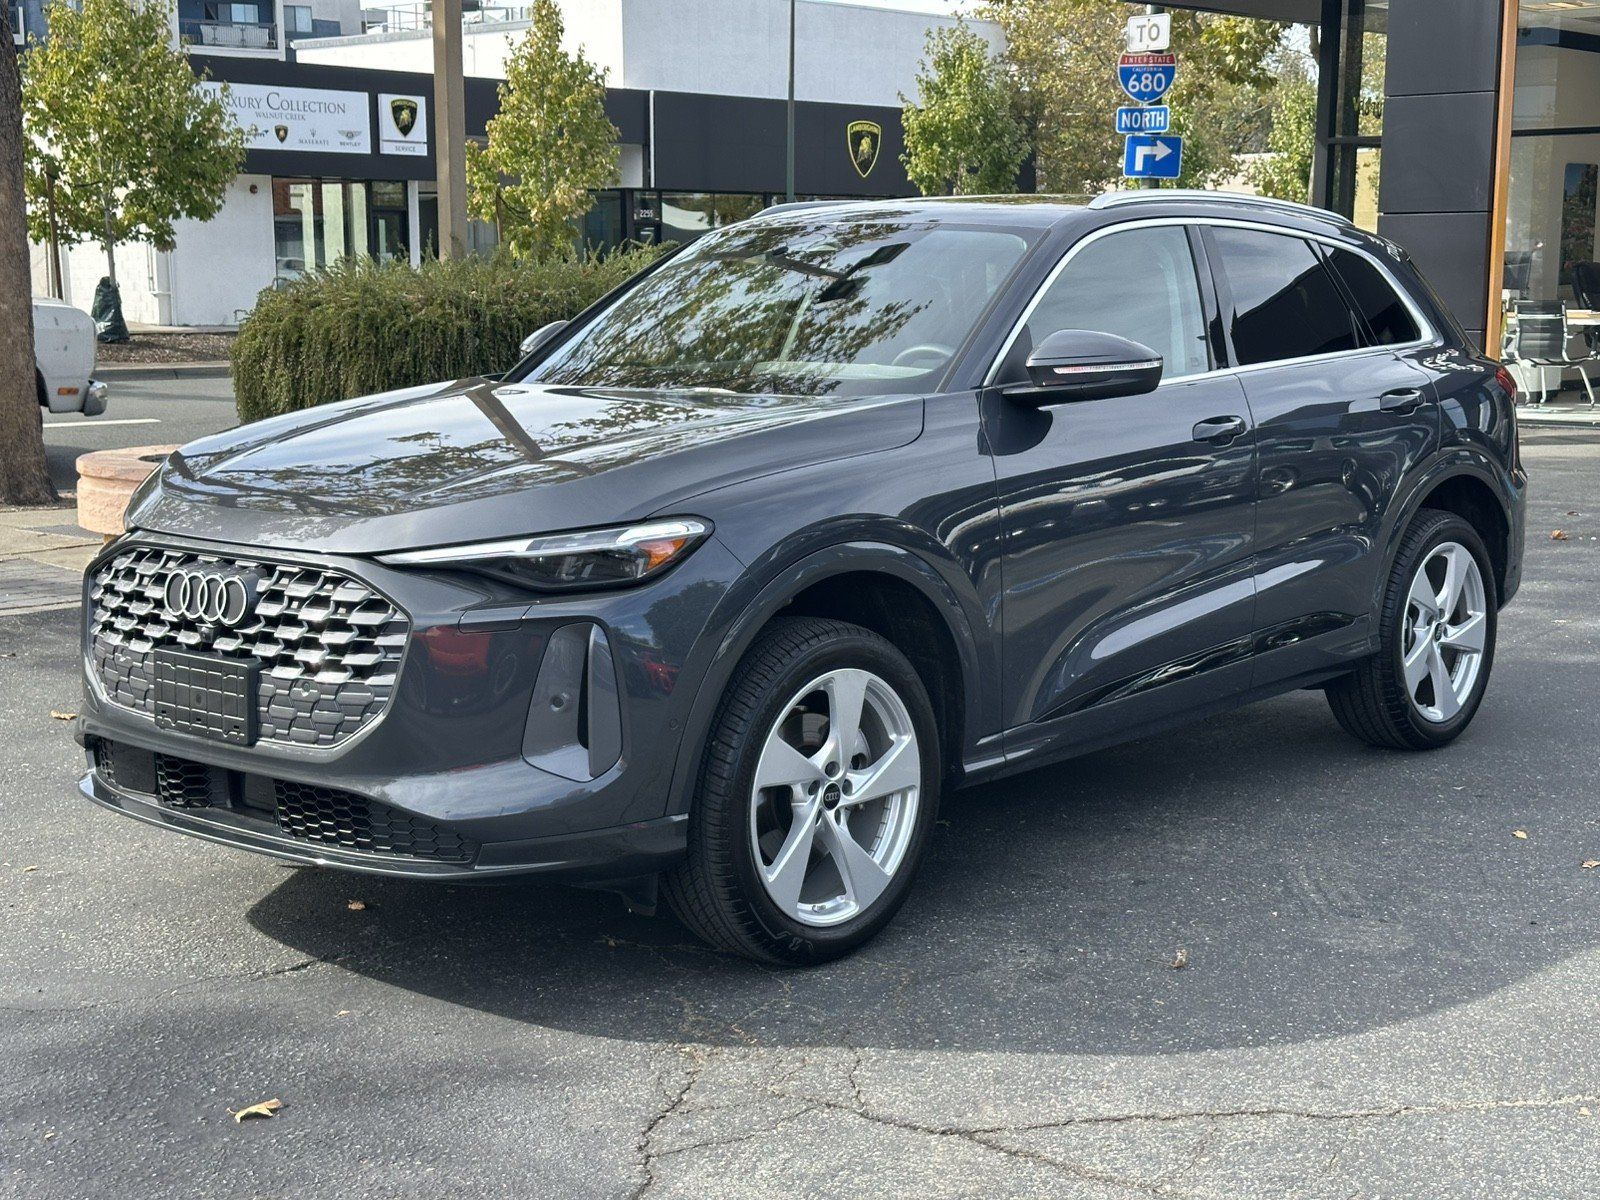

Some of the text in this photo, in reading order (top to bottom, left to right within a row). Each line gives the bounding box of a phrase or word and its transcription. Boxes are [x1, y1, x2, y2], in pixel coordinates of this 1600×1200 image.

[1137, 23, 1160, 43] TO
[1125, 56, 1171, 64] INTERSTATE
[1128, 73, 1166, 92] 680
[266, 92, 346, 114] COLLECTION
[255, 111, 306, 121] WALNUT CREEK
[1122, 111, 1165, 129] NORTH
